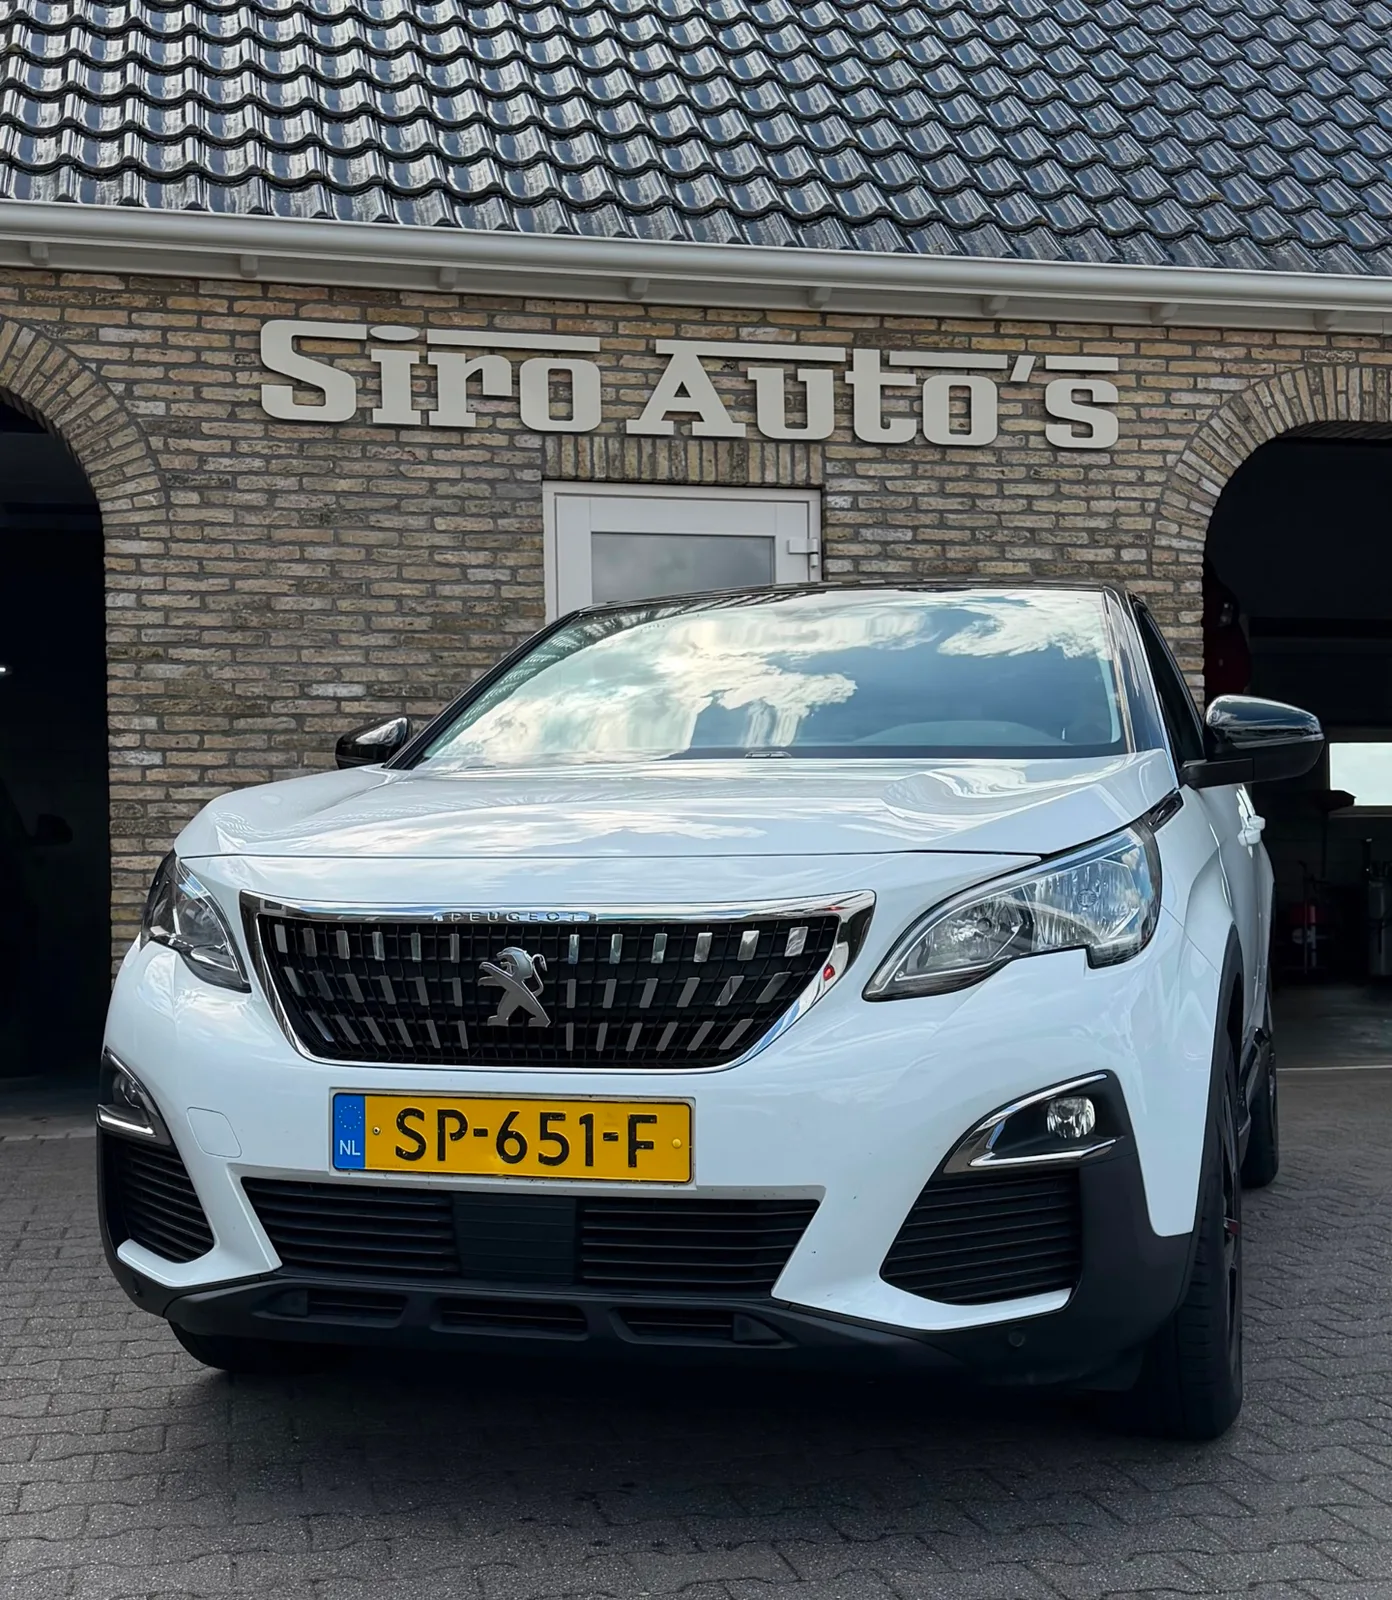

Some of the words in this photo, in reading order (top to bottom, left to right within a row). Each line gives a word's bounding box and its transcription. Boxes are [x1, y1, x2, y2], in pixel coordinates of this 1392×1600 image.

[260, 319, 602, 433] Siro
[626, 338, 1119, 449] Auto's
[450, 911, 579, 923] PEUGEOT
[339, 1139, 361, 1156] NL
[394, 1107, 658, 1168] SP-651-F
